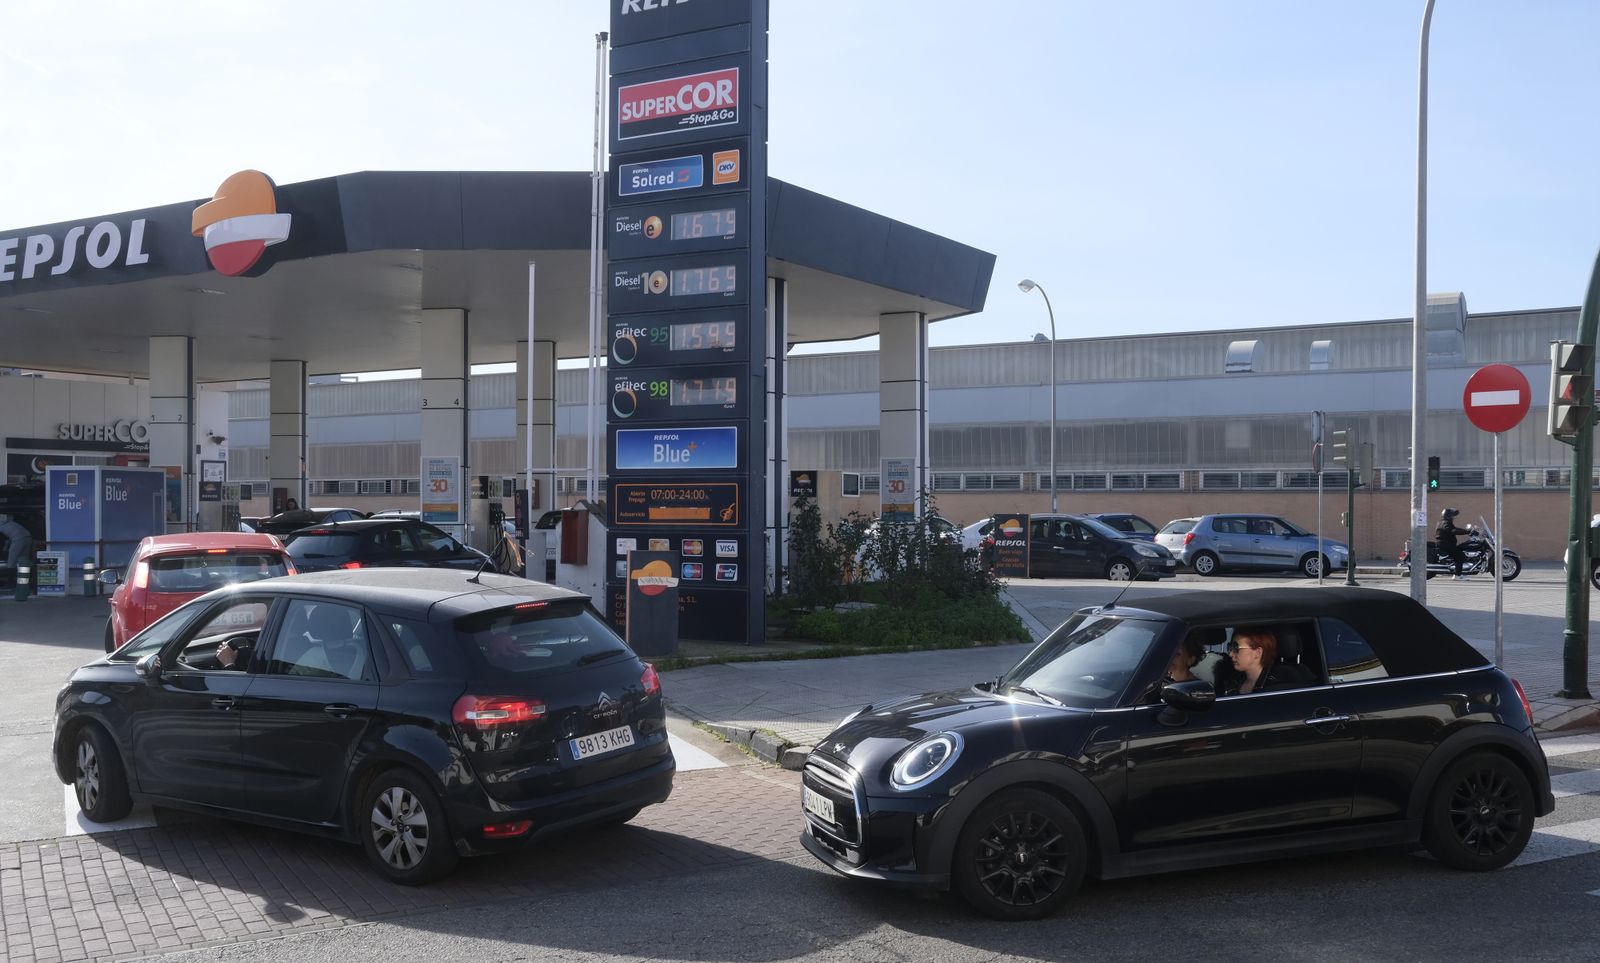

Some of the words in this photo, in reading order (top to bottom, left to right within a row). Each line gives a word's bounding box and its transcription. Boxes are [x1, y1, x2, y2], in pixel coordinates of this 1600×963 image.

[622, 79, 734, 121] SUPERCOR
[689, 109, 735, 125] Stop&Go
[632, 171, 674, 188] Solred
[616, 219, 642, 232] Diesel
[0, 218, 150, 282] EPSOL
[615, 274, 640, 287] Diesel
[650, 327, 668, 343] 95
[650, 381, 668, 397] 98
[579, 734, 608, 755] 9813
[609, 729, 631, 747] KHG
